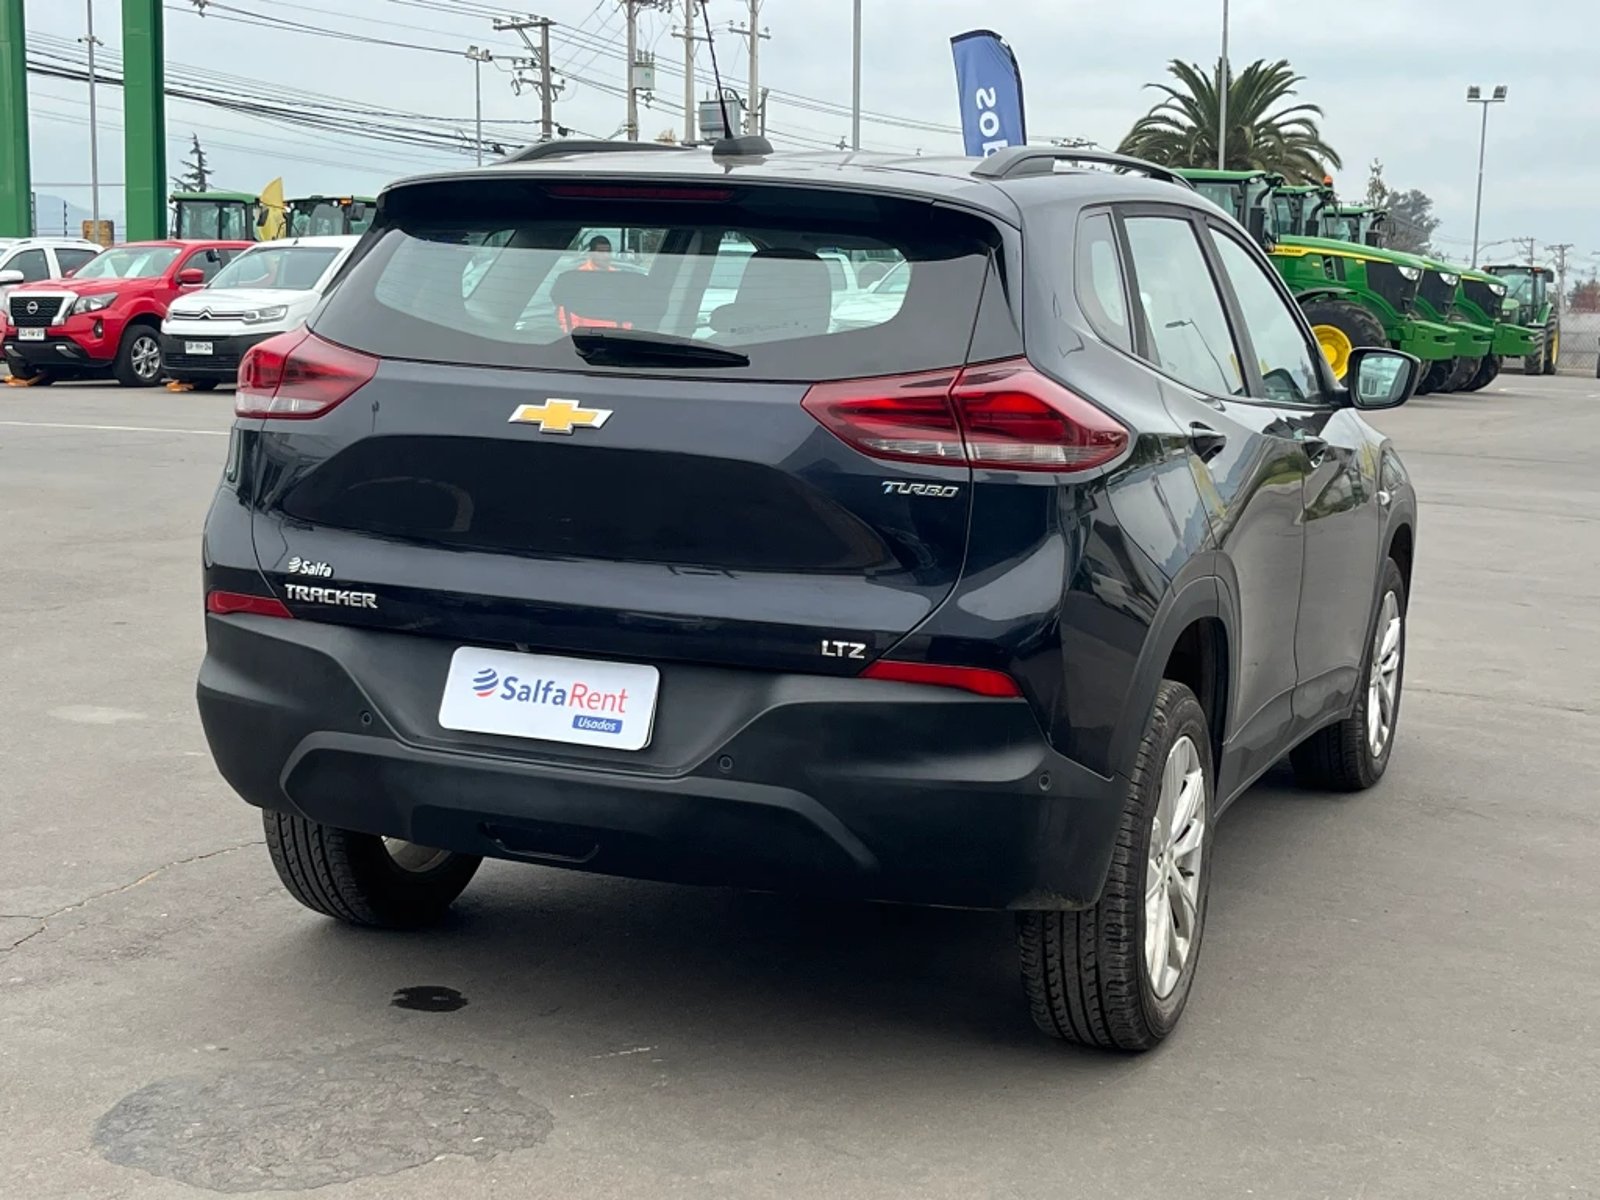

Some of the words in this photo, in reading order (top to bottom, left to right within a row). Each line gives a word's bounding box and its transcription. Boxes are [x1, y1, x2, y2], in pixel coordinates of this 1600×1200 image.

[881, 480, 959, 498] TURBO
[300, 560, 332, 578] Salfa
[284, 583, 378, 609] TRACKER
[821, 639, 866, 659] LTZ
[500, 676, 628, 713] SalfaRent
[577, 717, 617, 732] Usados
